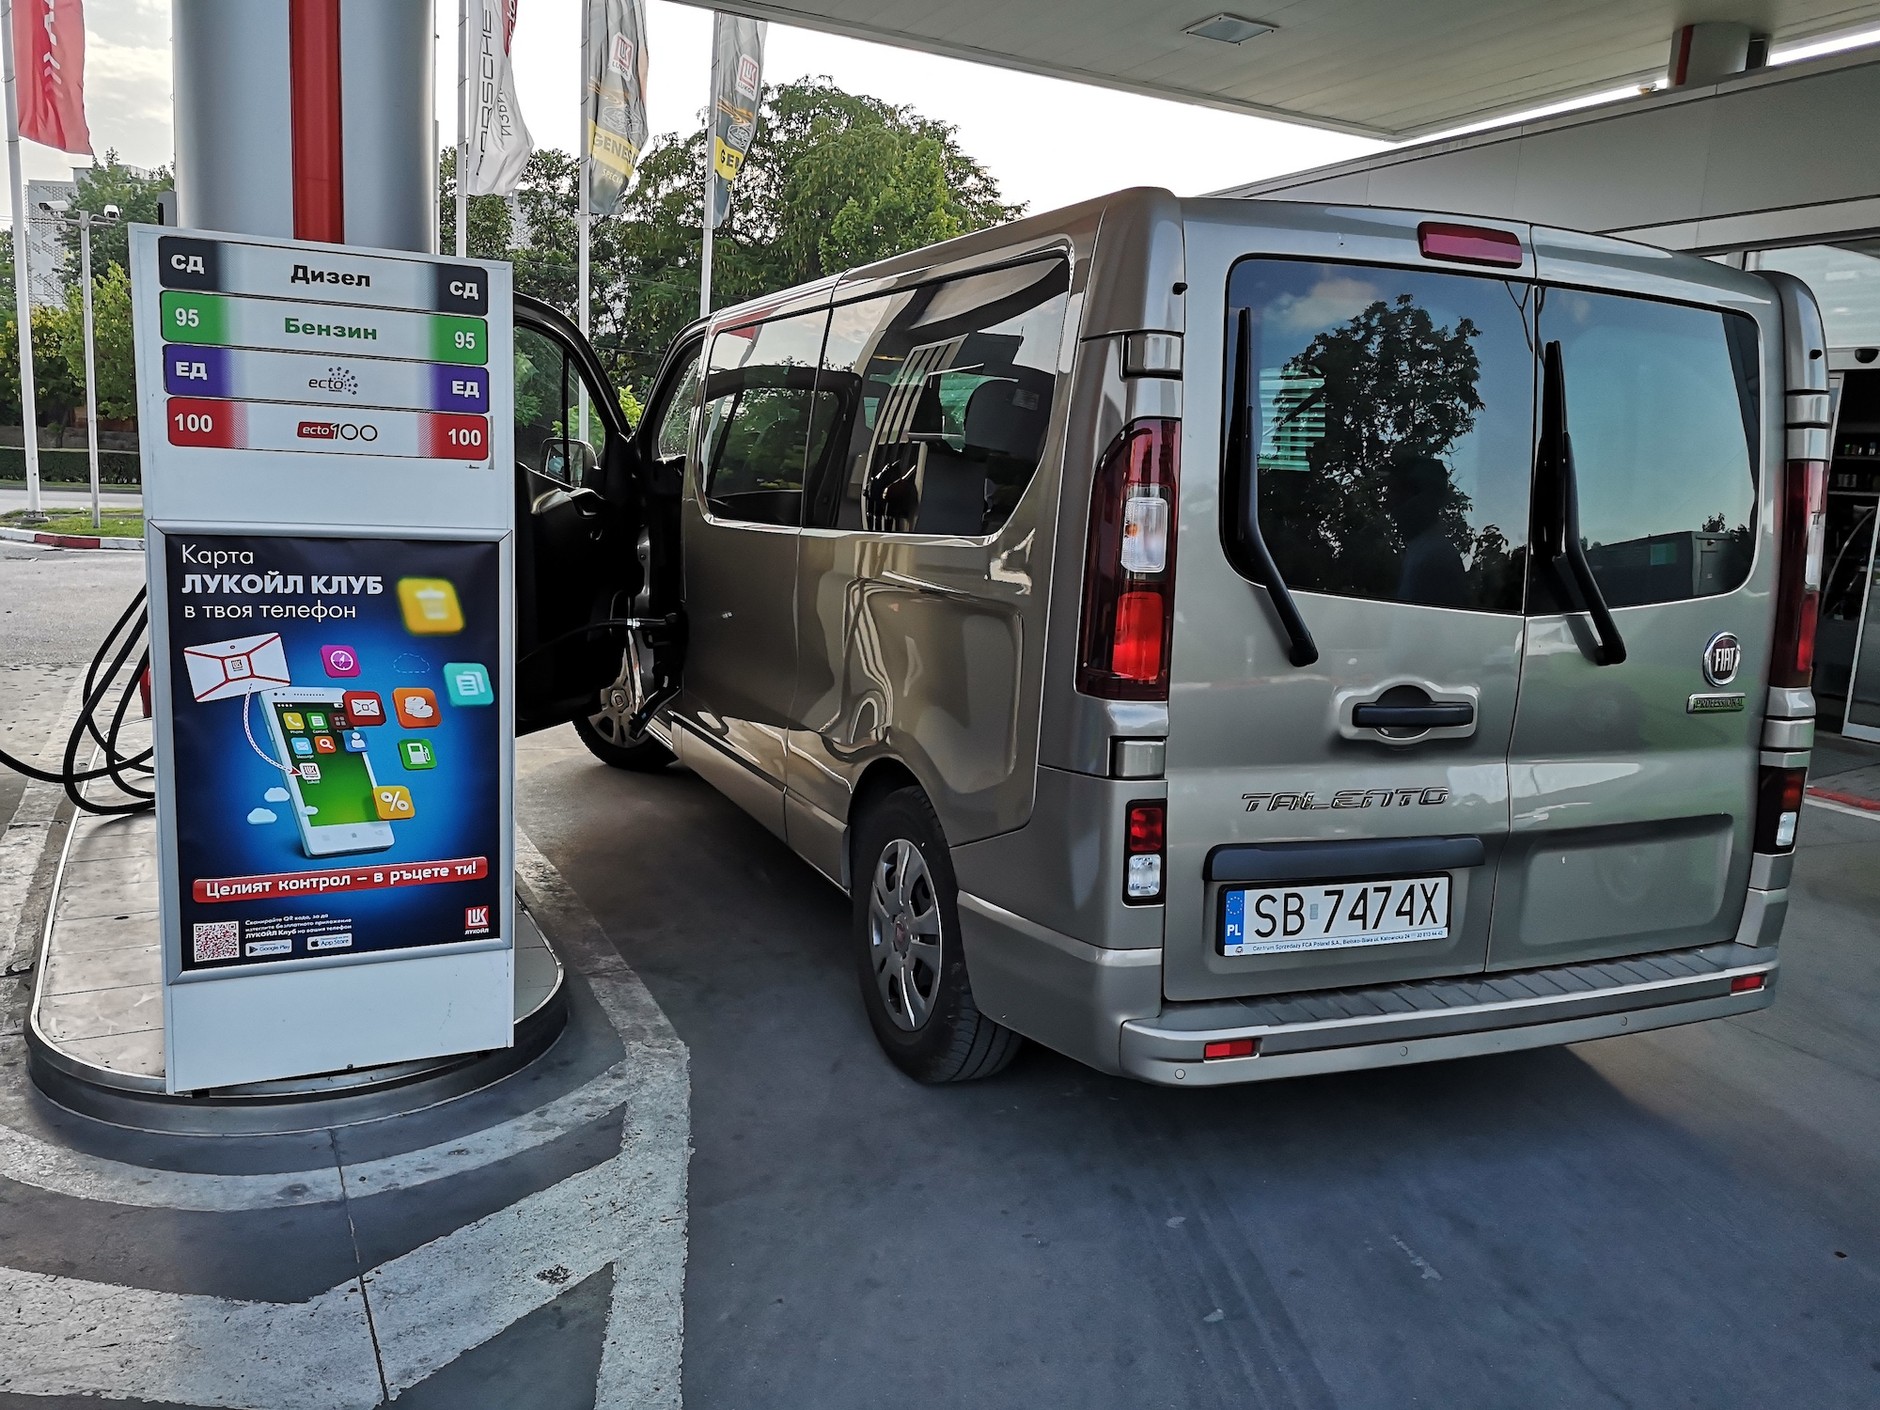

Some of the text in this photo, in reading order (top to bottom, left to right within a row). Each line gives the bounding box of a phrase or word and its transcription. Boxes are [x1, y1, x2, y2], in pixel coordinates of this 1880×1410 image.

[170, 254, 479, 301] СД Дизел СД
[175, 307, 476, 350] 95 Бензин 95
[175, 361, 480, 398] ЕД ecto ЕД
[174, 413, 213, 433] 100
[448, 428, 482, 447] 100
[181, 544, 254, 569] Карта
[181, 571, 384, 595] ЛУКОЙЛ КЛУБ
[184, 600, 356, 623] в твоя телефон
[1714, 647, 1735, 671] FIAT
[1241, 787, 1449, 812] TALENTO
[206, 880, 272, 898] Целият
[278, 875, 351, 892] контрол
[374, 872, 383, 882] в
[390, 866, 449, 884] ръцете
[455, 861, 477, 875] ти!
[1255, 882, 1440, 938] SB 7474X
[245, 929, 277, 939] ЛУКОЙЛ
[278, 929, 297, 937] Клуб
[1227, 924, 1241, 937] PL
